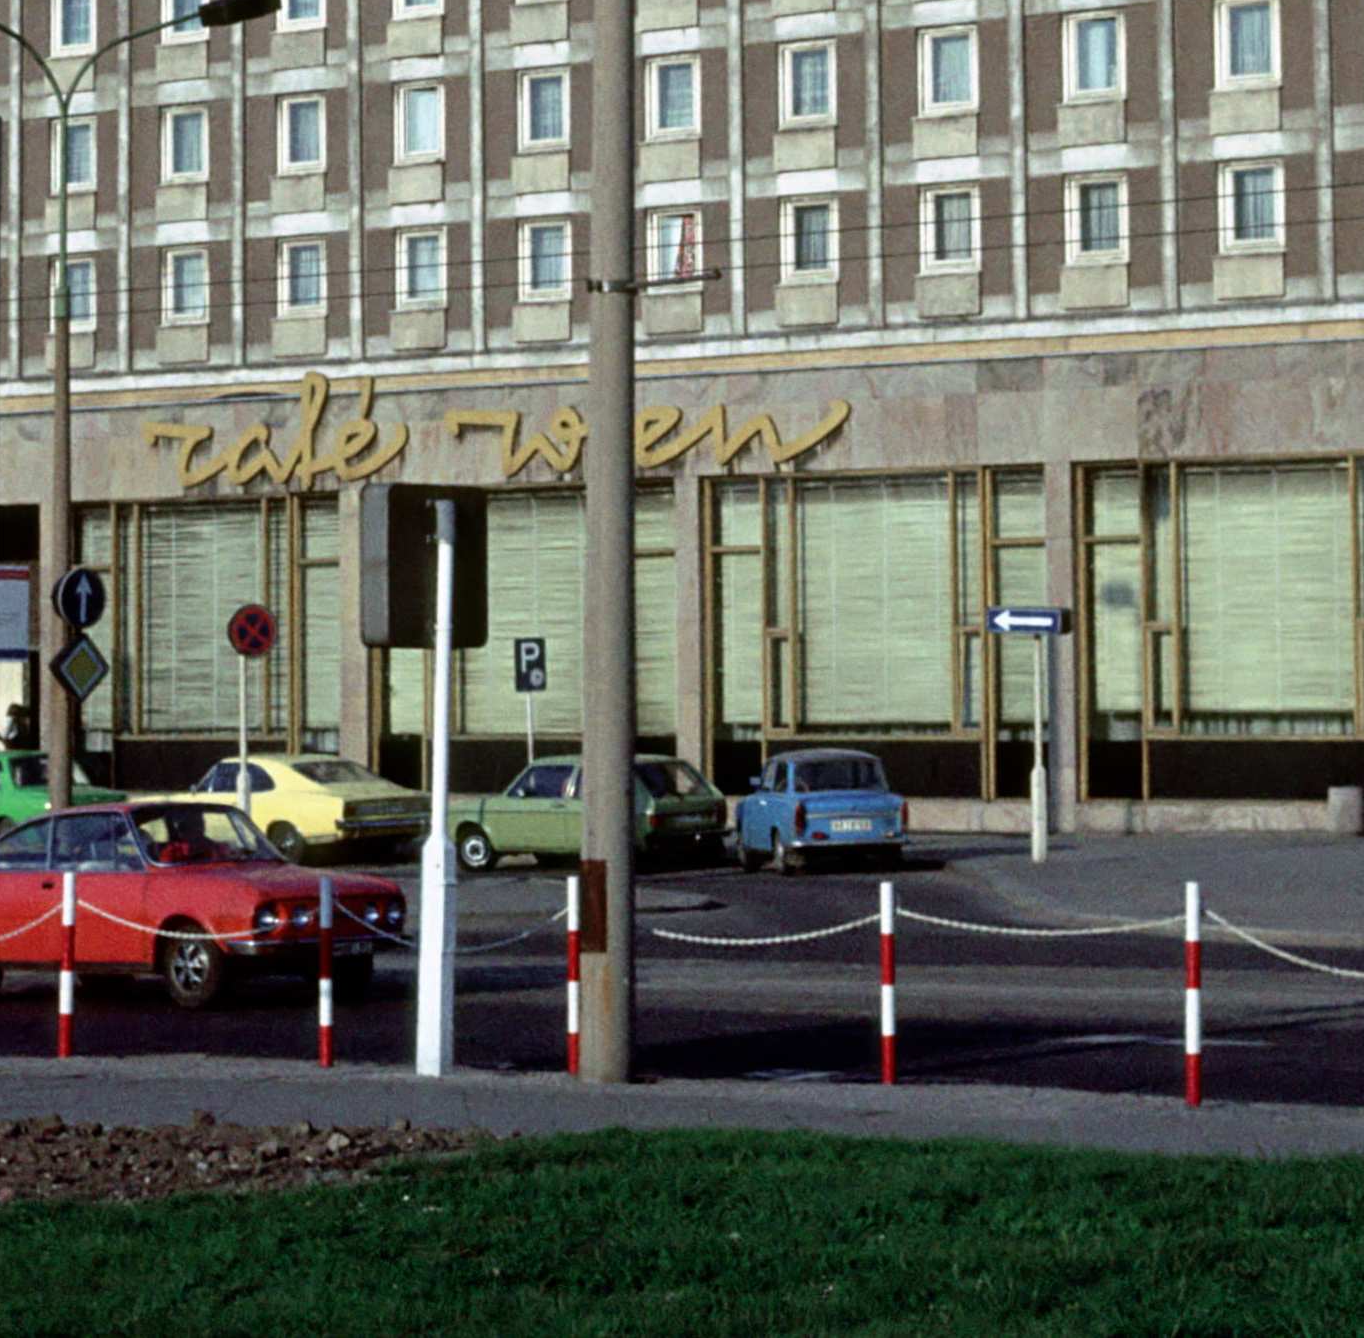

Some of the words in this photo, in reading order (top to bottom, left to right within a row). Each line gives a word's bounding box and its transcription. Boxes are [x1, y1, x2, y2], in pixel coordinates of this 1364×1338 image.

[143, 370, 409, 490] café
[446, 398, 852, 478] wen
[520, 642, 540, 673] P
